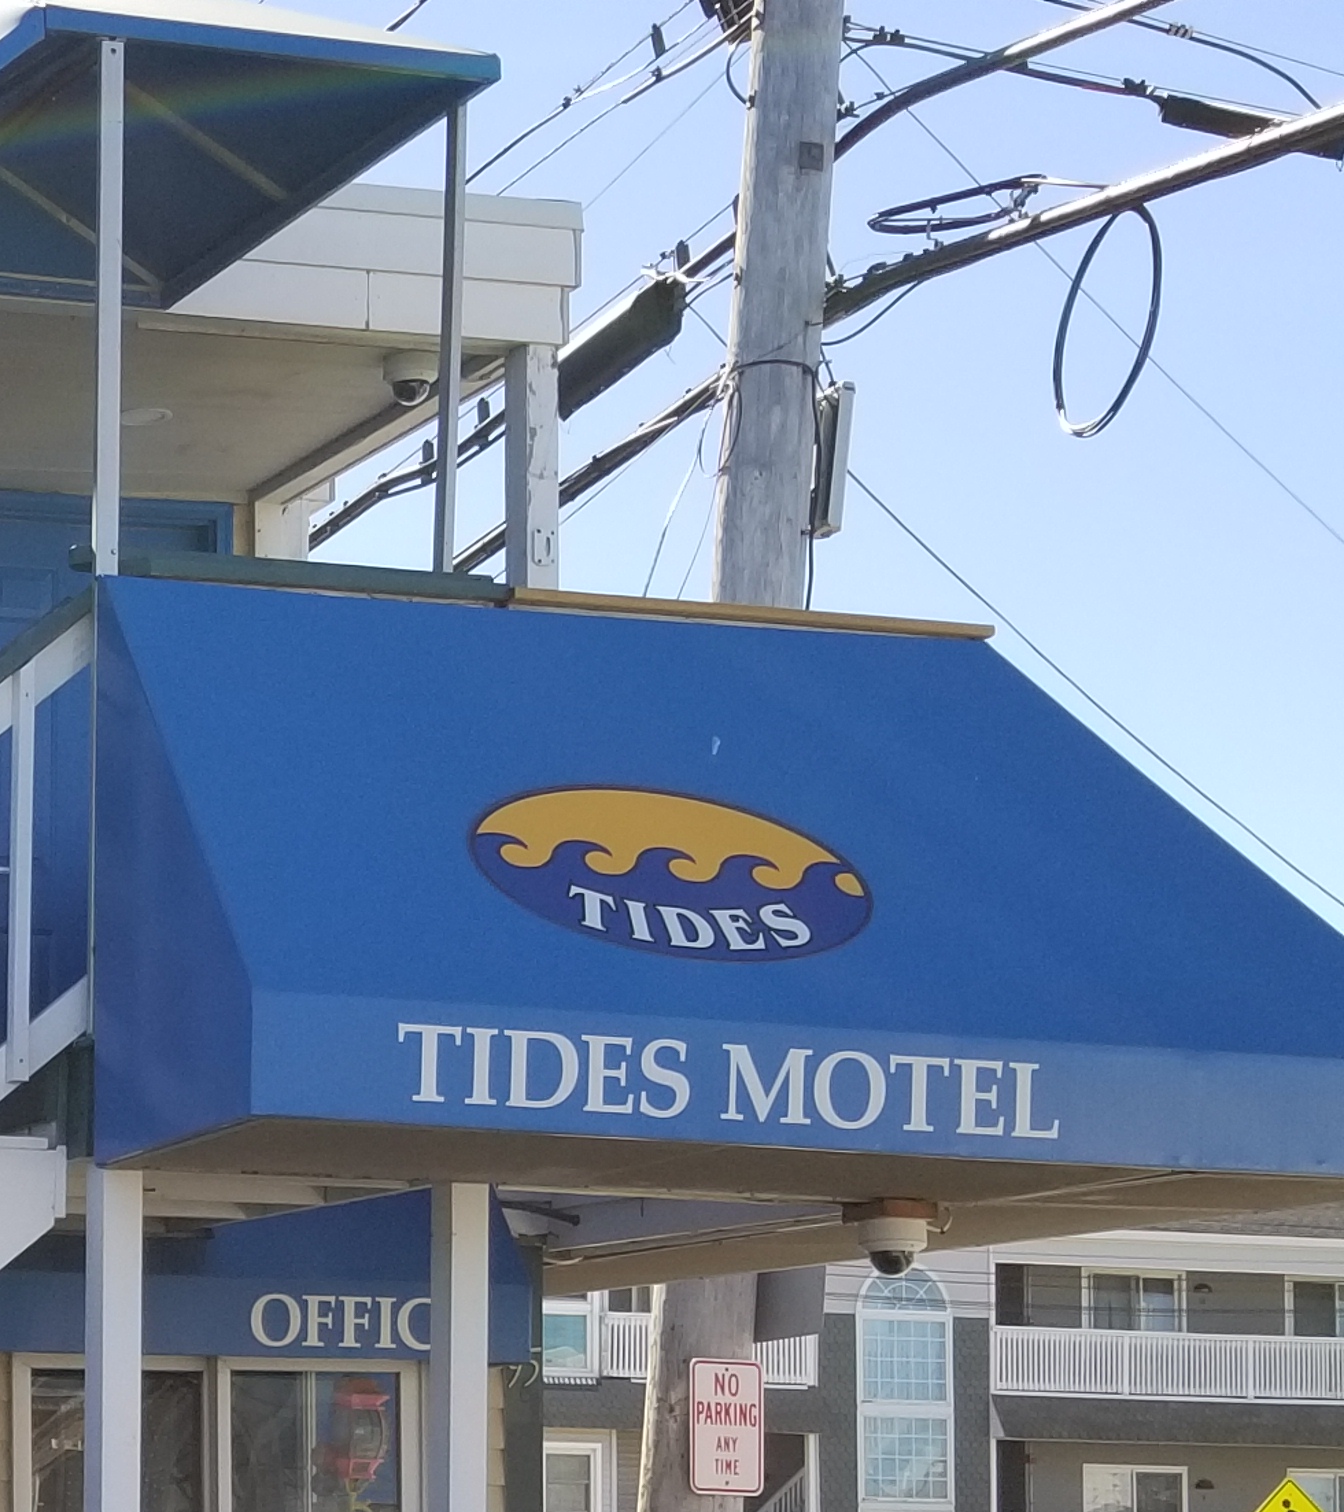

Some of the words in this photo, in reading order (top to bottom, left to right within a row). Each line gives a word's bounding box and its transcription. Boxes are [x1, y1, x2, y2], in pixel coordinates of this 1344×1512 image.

[569, 884, 811, 950] TIDES
[398, 1022, 691, 1118] TIDES
[720, 1043, 1060, 1140] MOTEL
[250, 1293, 431, 1351] OFFIC
[714, 1372, 739, 1397] NO
[696, 1401, 757, 1428] PARKING
[716, 1436, 738, 1452] ANY
[715, 1458, 740, 1476] TIME
